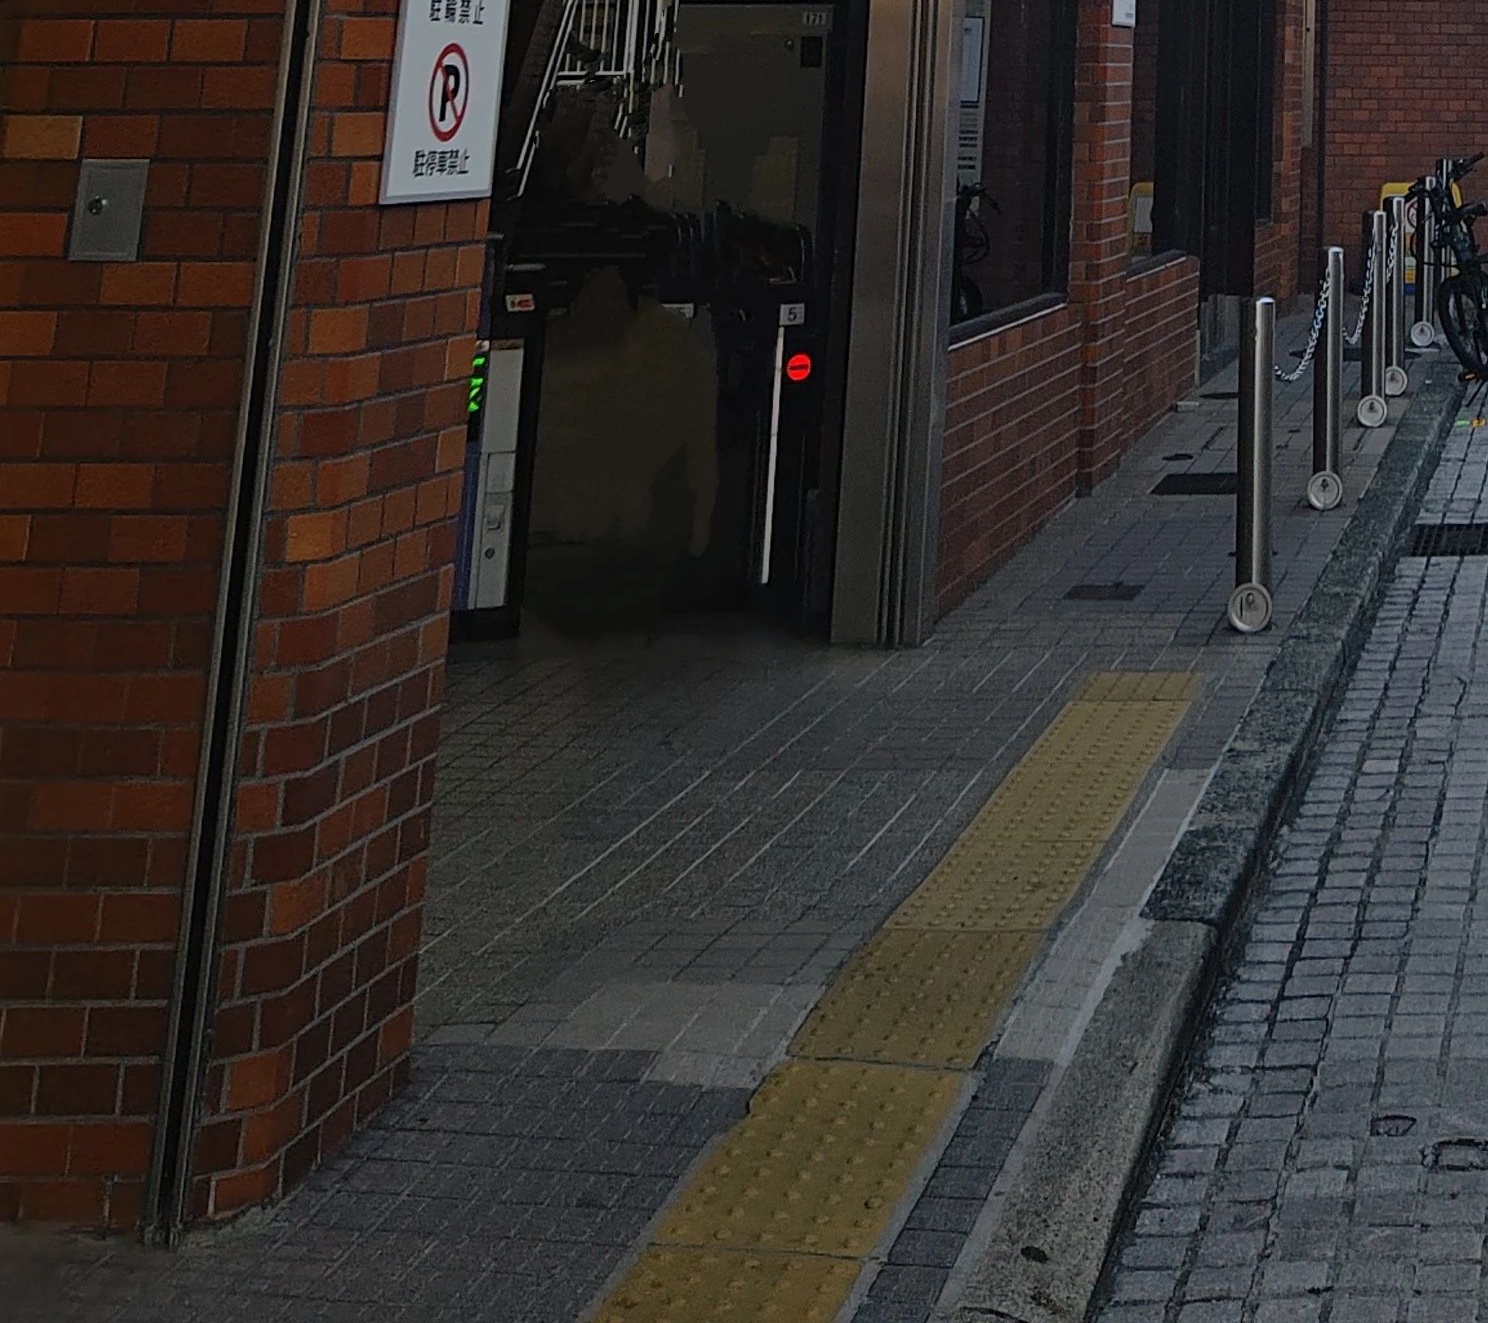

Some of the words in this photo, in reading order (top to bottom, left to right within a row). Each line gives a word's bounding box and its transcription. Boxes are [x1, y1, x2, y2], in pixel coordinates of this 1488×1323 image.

[413, 149, 470, 178] 駐停車禁止
[788, 307, 797, 322] 5
